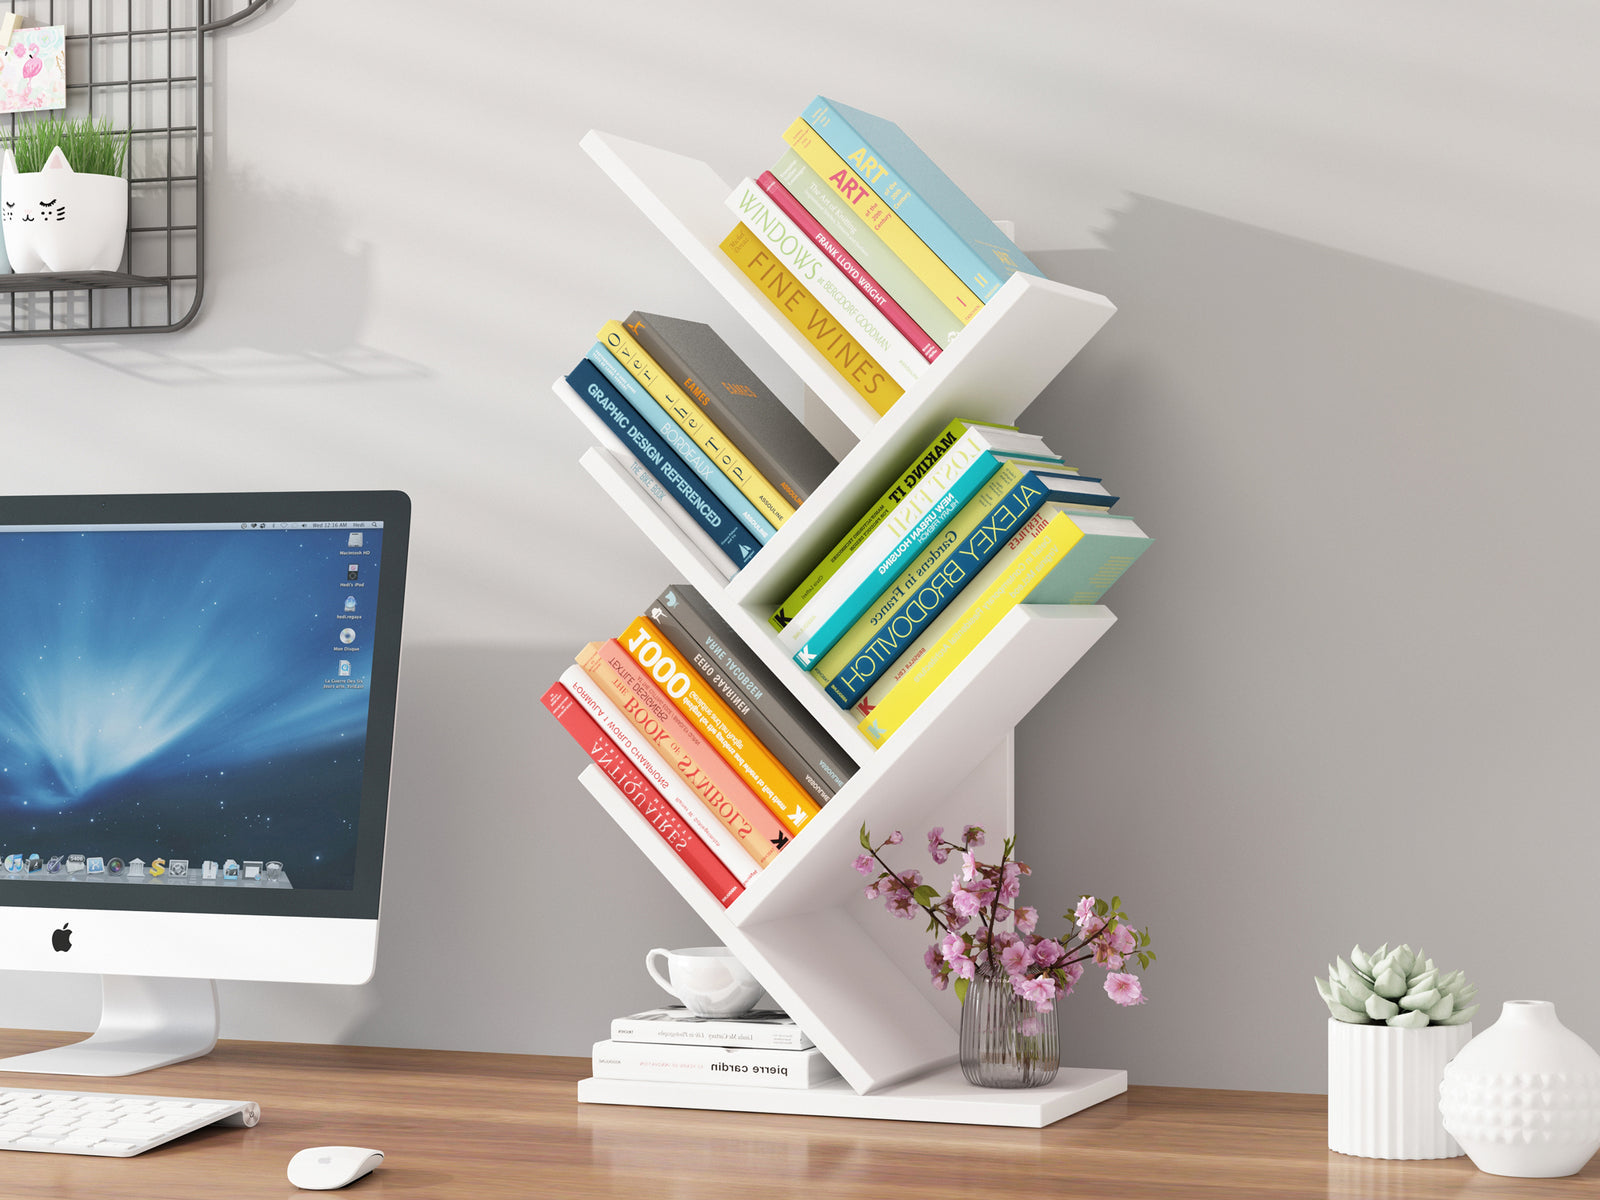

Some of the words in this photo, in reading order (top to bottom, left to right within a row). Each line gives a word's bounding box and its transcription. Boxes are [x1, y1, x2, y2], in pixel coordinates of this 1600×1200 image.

[828, 165, 869, 207] ART
[847, 144, 888, 186] ART
[808, 182, 821, 196] The
[819, 194, 831, 206] Art
[873, 212, 892, 231] Century
[733, 188, 824, 281] WINDOWS
[822, 279, 859, 317] BERGDORF
[854, 312, 892, 351] GOODMAN
[814, 232, 839, 257] FRANK
[835, 254, 860, 279] LLOYD
[856, 275, 886, 306] WRIGHT
[746, 250, 806, 312] FINE
[801, 308, 886, 395] WINES
[682, 377, 711, 406] EAMES
[585, 382, 630, 429] GRAPHIC
[626, 425, 664, 465] DESIGN
[659, 461, 723, 528] REFERENCED
[629, 461, 642, 475] THE
[659, 422, 714, 480] BORDEAUX
[742, 510, 768, 538] ASSOULINE
[758, 494, 783, 521] ASSOULINE
